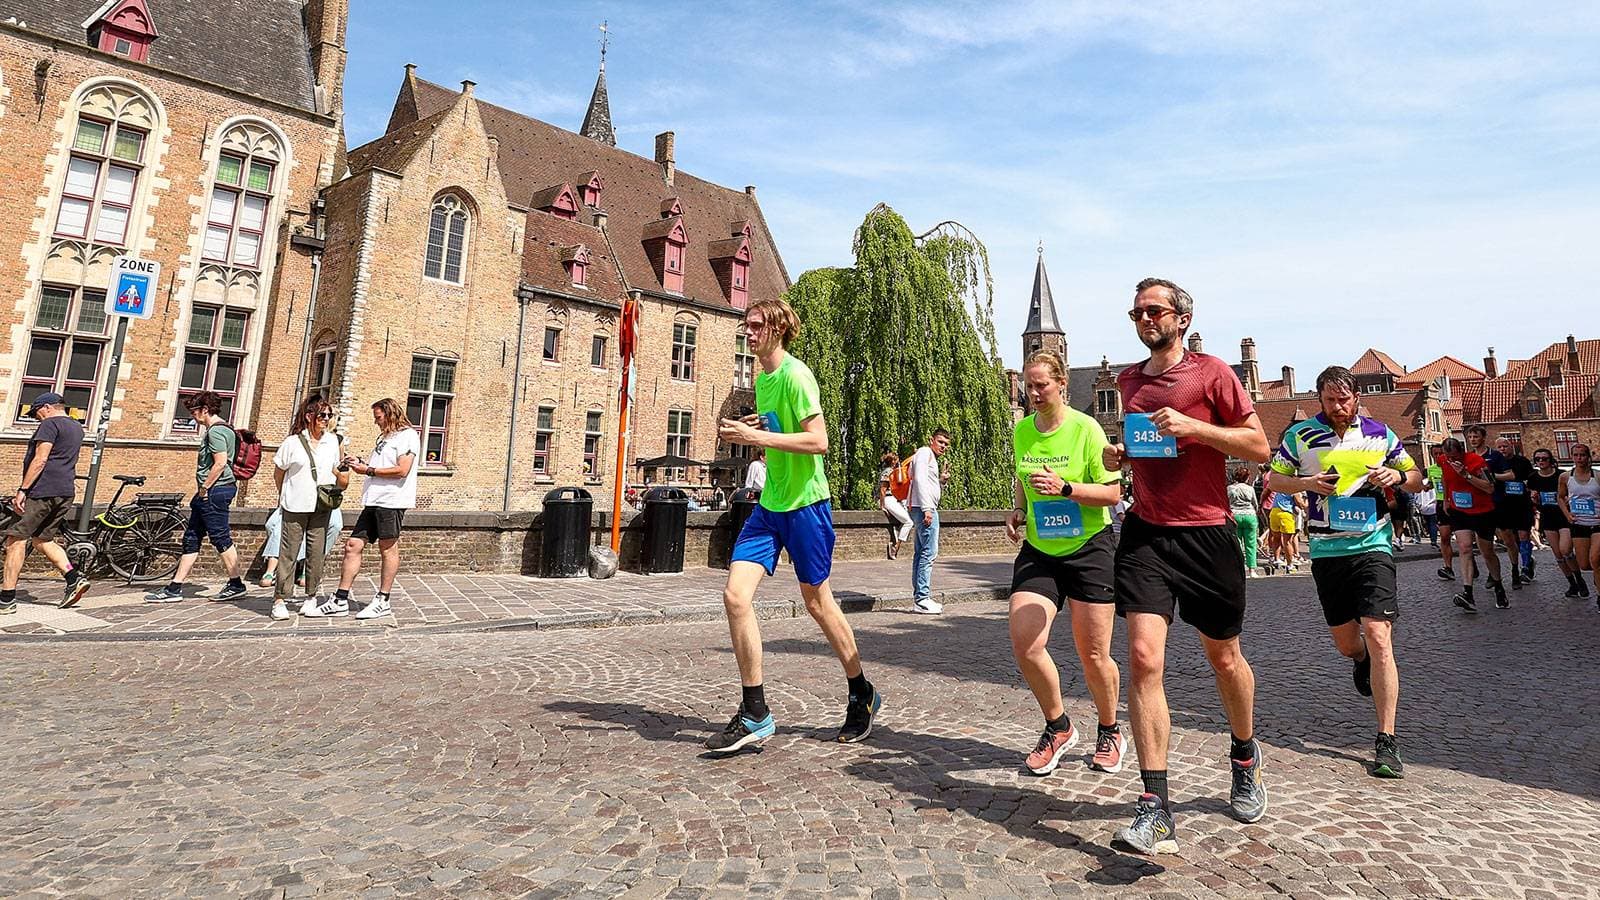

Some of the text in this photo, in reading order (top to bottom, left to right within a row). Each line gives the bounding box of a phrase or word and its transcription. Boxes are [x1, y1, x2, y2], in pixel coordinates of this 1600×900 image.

[119, 258, 155, 273] ZONE
[1021, 455, 1070, 463] BASISSCHOLEN
[1043, 514, 1071, 527] 2250
[1338, 510, 1367, 521] 3141
